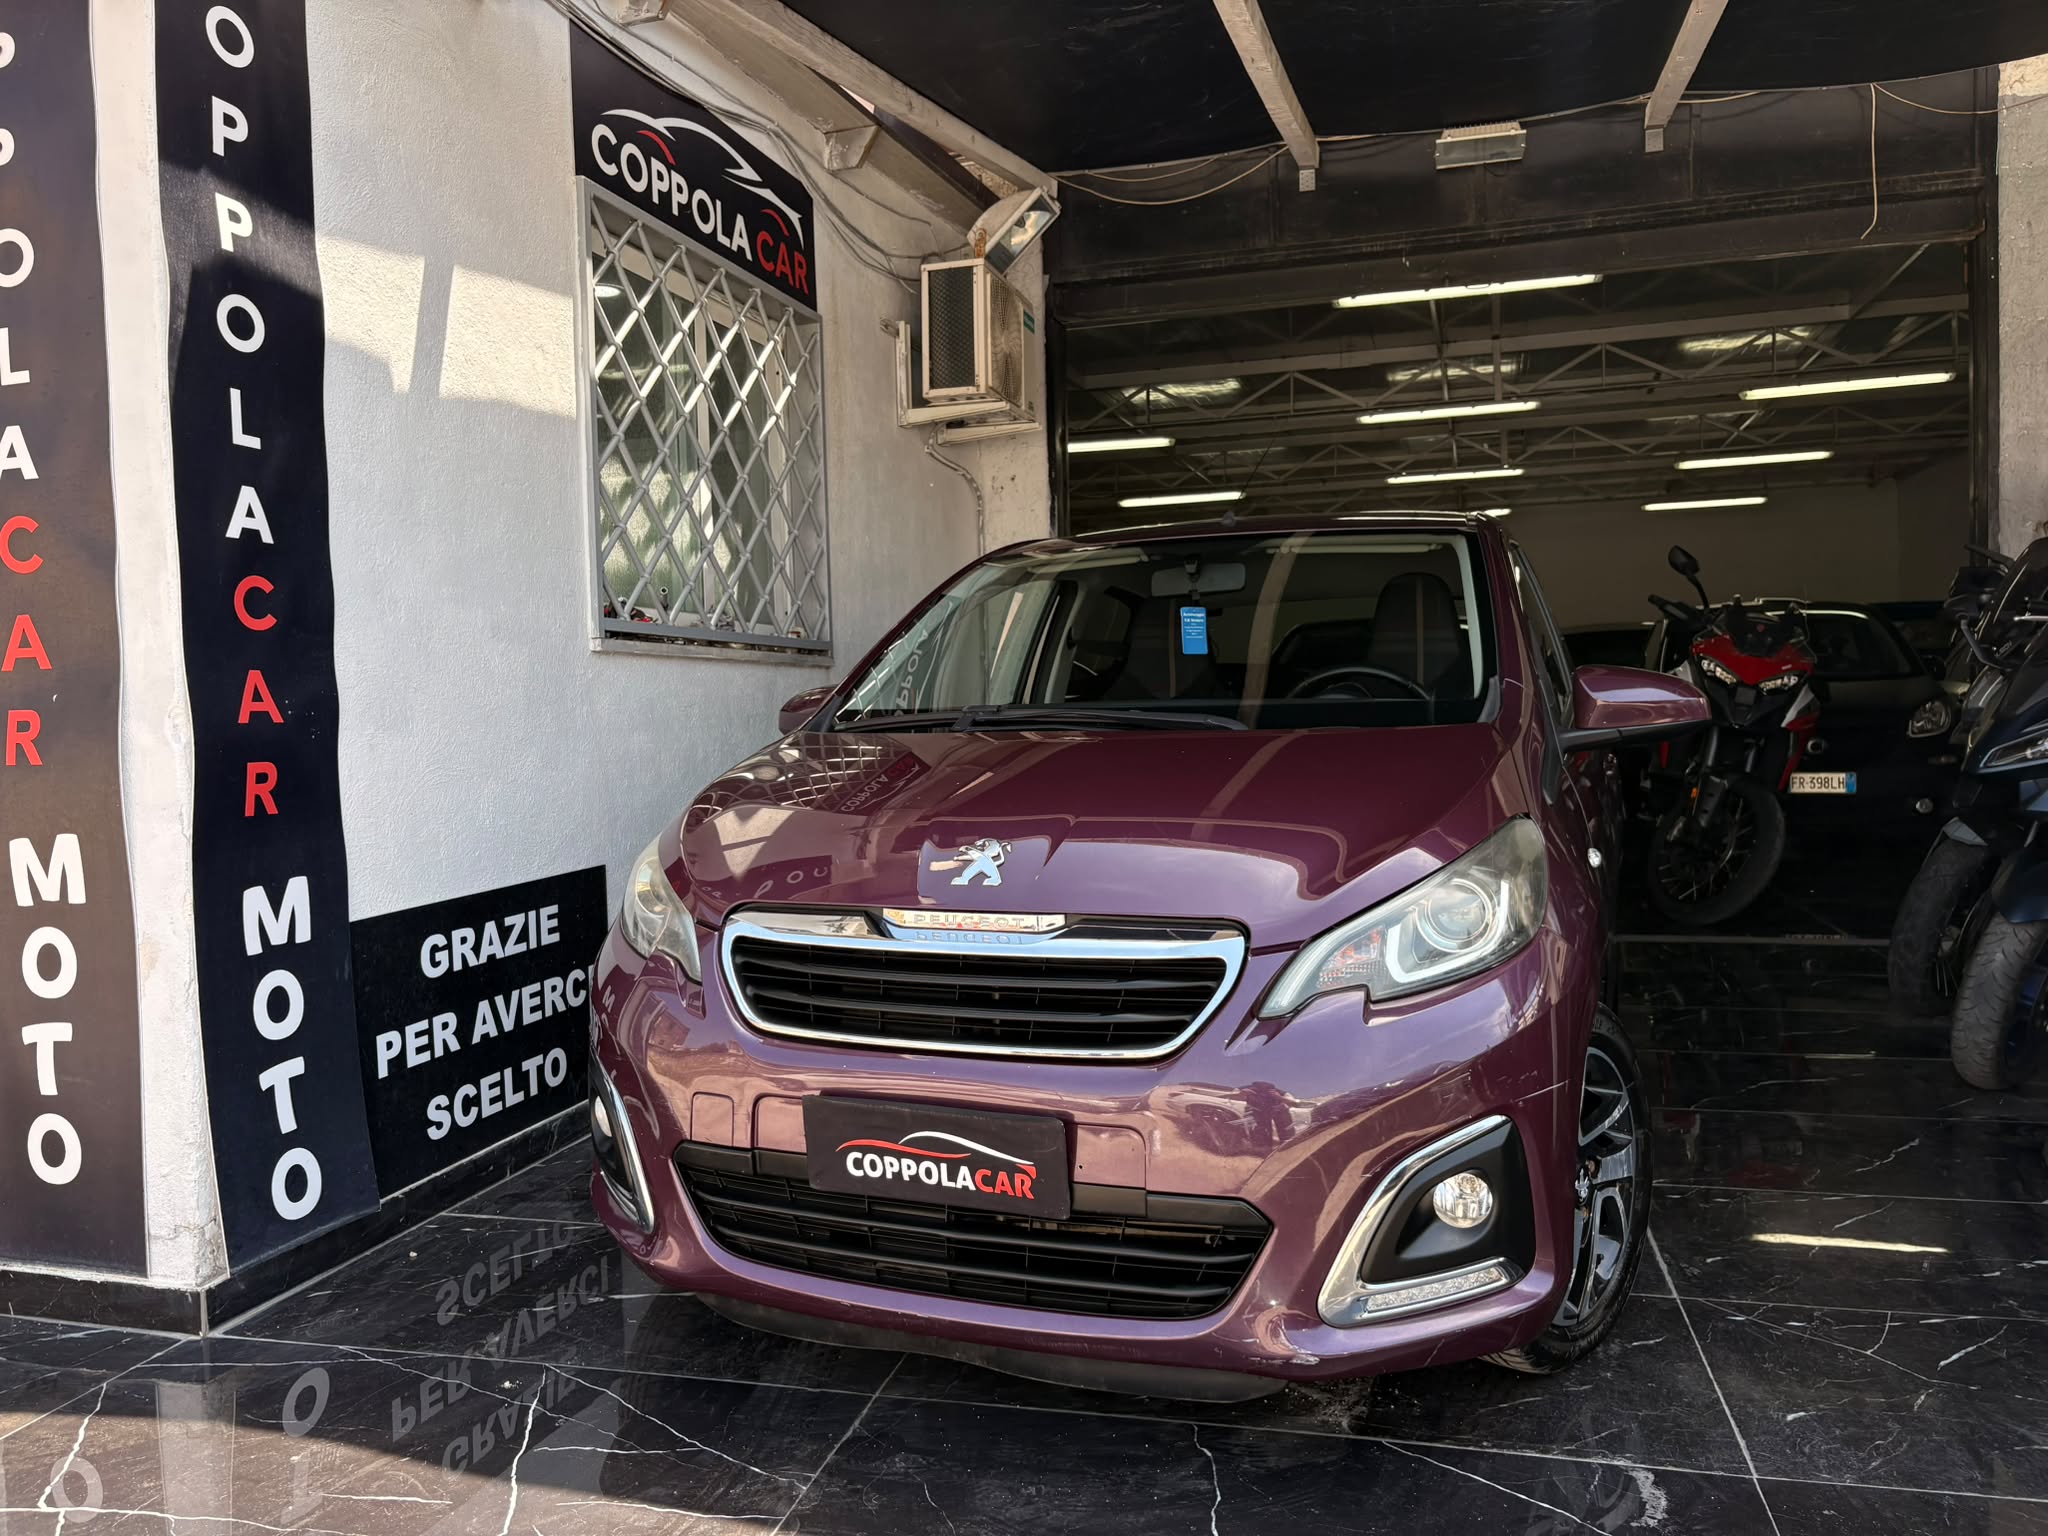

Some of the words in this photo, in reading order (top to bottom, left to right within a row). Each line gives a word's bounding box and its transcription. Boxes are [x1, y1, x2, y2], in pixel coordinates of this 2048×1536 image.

[420, 904, 561, 979] GRAZIE
[913, 913, 1025, 930] PEUGEOT
[9, 833, 87, 1185] MOTO
[242, 875, 322, 1221] MOTO
[375, 1011, 462, 1080] PER
[426, 1047, 568, 1141] SCELTO
